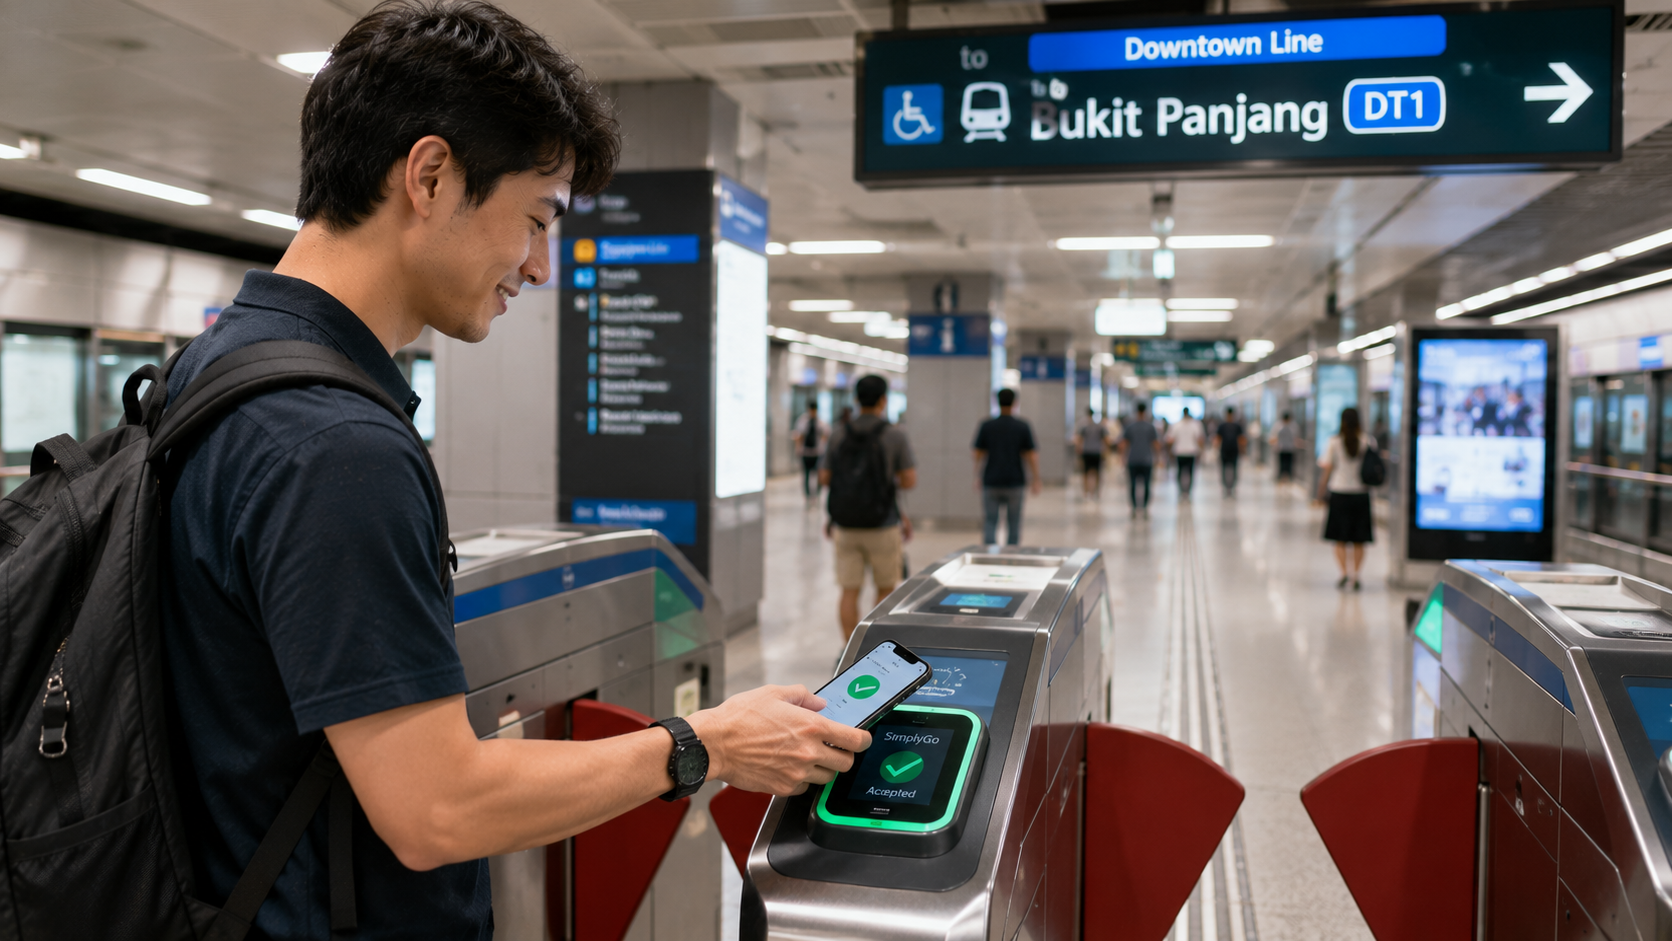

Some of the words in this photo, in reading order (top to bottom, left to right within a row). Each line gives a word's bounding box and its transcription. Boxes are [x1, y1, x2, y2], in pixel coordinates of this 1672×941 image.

[960, 45, 988, 70] to
[1124, 33, 1262, 62] Downtown
[1270, 28, 1324, 54] Line
[1030, 97, 1143, 141] Bukit
[1156, 92, 1329, 145] Panjang
[1364, 89, 1424, 121] DT1
[883, 731, 940, 745] SimplyGo
[865, 786, 917, 799] Accepted
